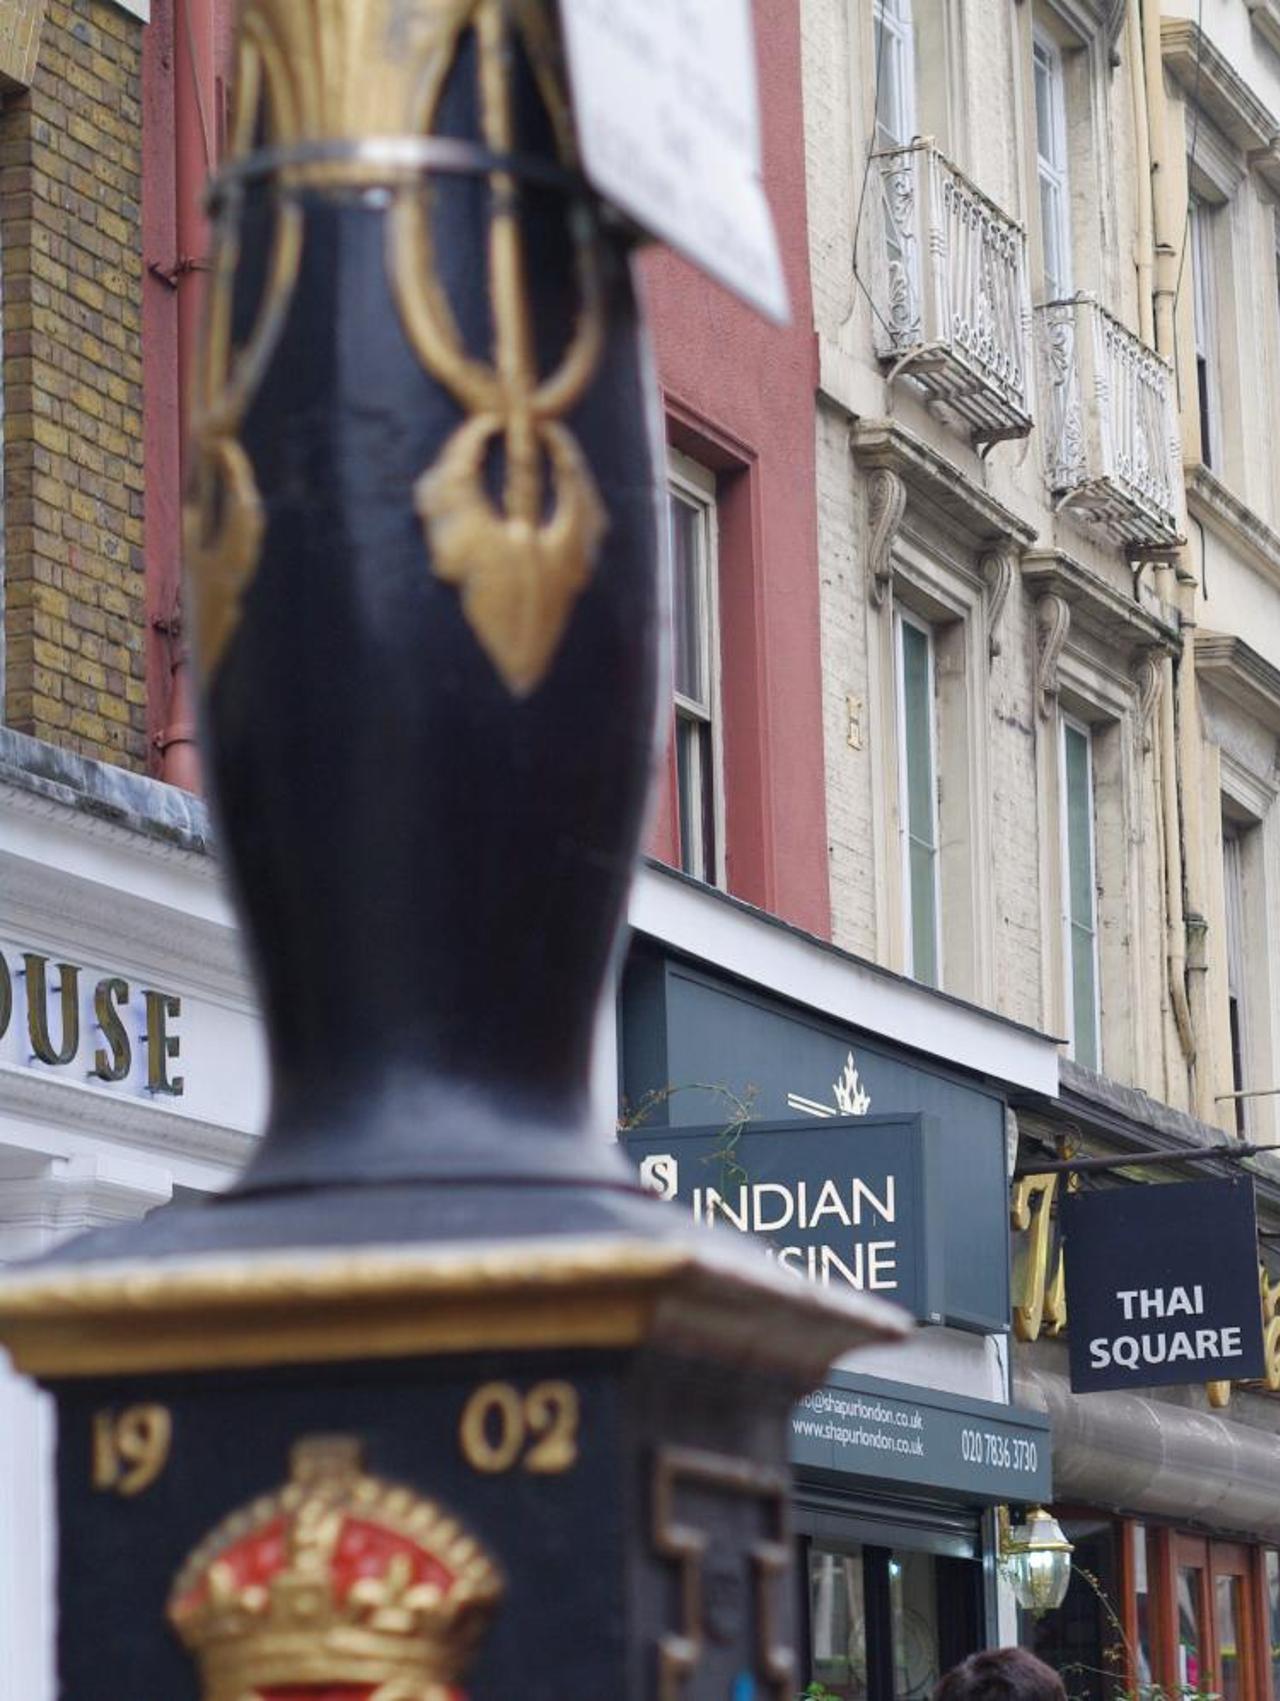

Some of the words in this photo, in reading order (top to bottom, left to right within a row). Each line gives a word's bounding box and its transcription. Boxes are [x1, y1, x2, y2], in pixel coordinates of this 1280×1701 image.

[0, 953, 184, 1096] USE
[693, 1175, 896, 1232] INDIAN
[767, 1240, 898, 1291] SINE
[1116, 1285, 1205, 1320] THAI
[1089, 1327, 1243, 1371] SQUARE
[91, 1405, 172, 1495] 19
[460, 1380, 578, 1472] 02
[792, 1419, 924, 1456] www.shapurlondon.co.uk
[961, 1429, 983, 1462] 020
[984, 1434, 1010, 1468] 7836
[1012, 1439, 1038, 1473] 3730
